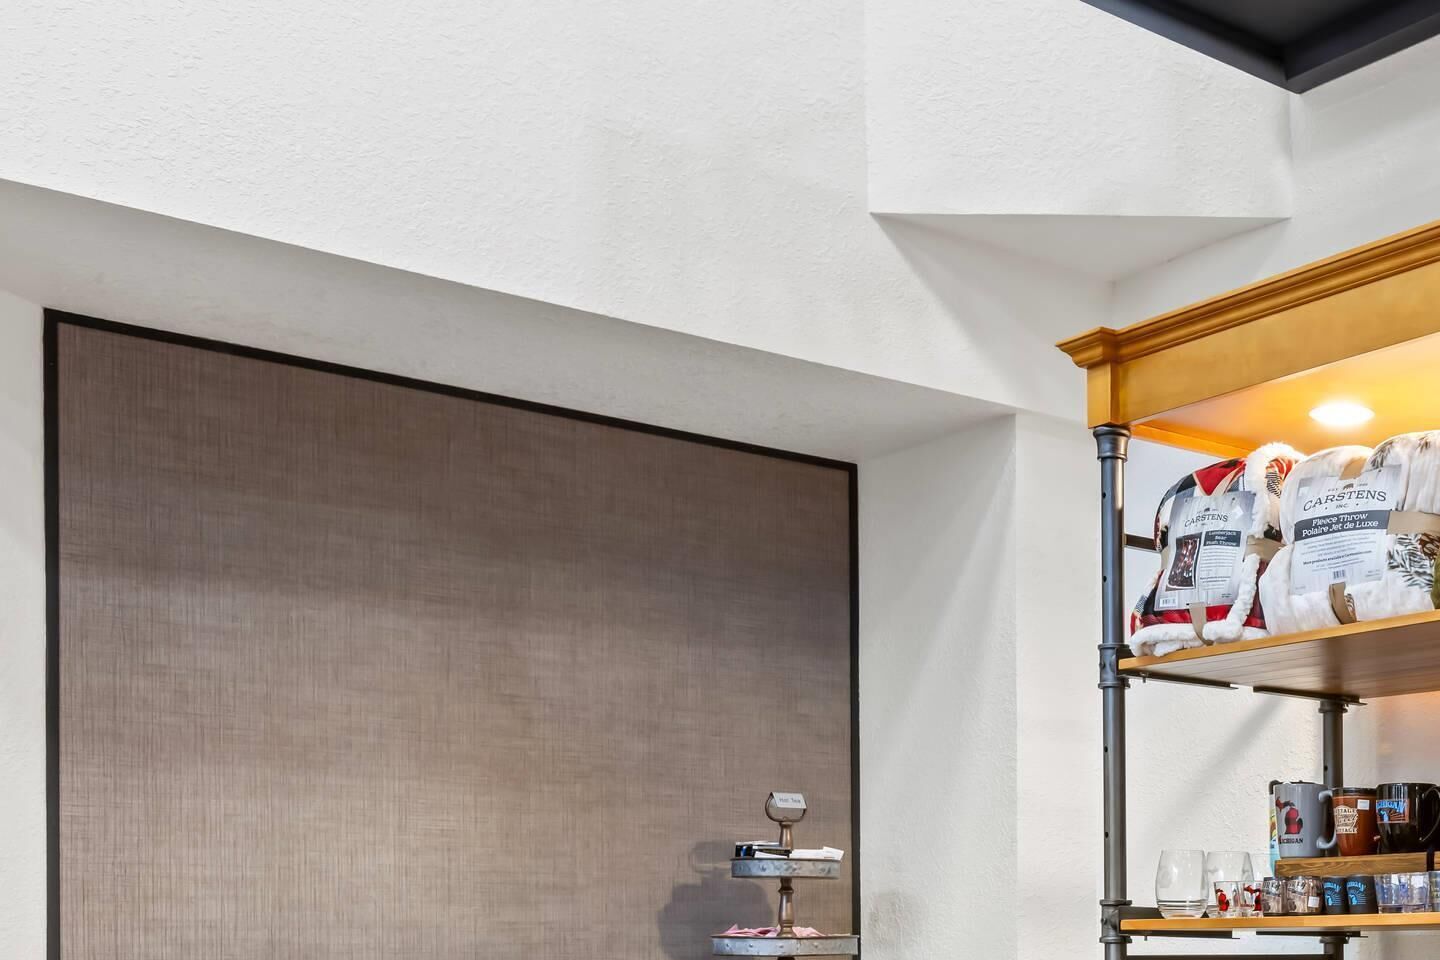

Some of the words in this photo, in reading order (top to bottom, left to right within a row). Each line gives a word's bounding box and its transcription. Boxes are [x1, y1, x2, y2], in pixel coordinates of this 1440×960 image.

[1303, 490, 1387, 511] CARSTENS
[1184, 513, 1229, 528] CARSTENS
[1312, 515, 1338, 527] Fleece
[1339, 512, 1368, 522] Throw
[1302, 526, 1329, 538] Polaire
[1329, 522, 1342, 533] Jet
[1343, 520, 1355, 529] de
[1355, 519, 1379, 528] Luxe
